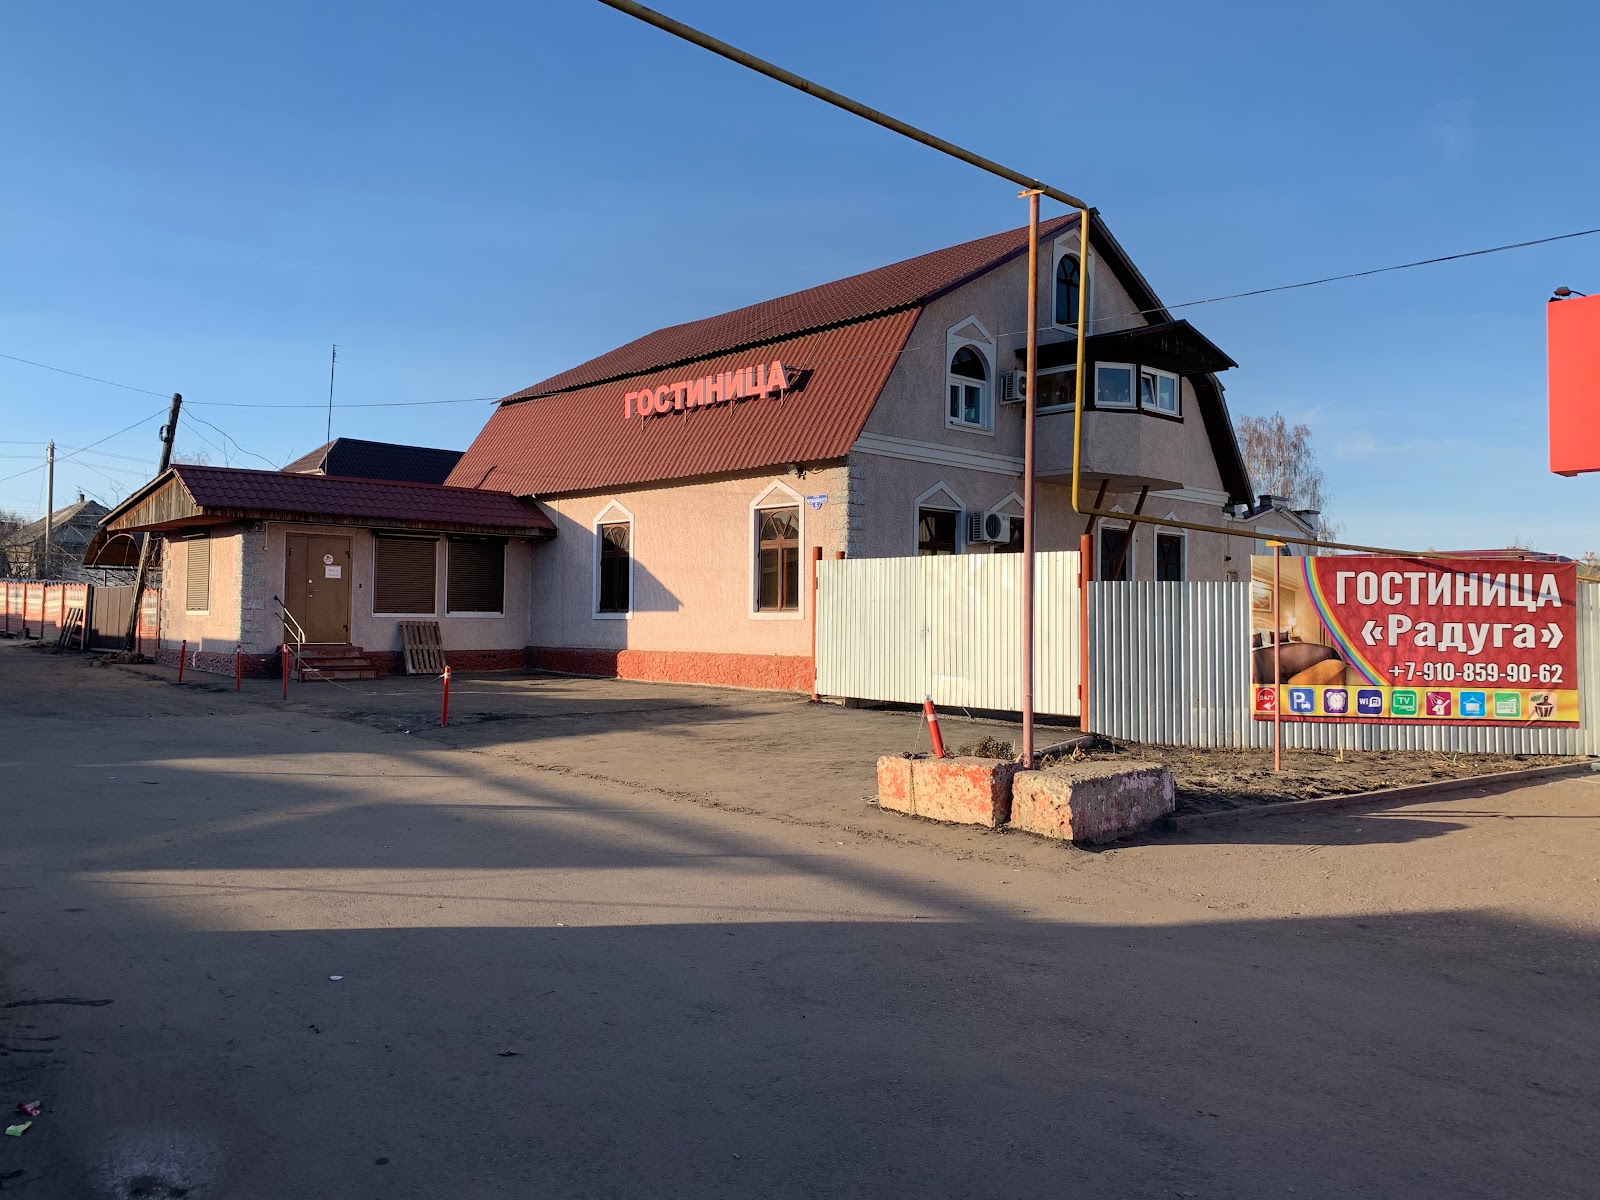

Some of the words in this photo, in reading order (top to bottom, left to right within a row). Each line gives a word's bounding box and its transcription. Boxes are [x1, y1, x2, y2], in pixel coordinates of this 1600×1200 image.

[624, 360, 788, 419] ГОСТИНИЦА
[1336, 571, 1562, 612] ГОСТИНИЦА
[1360, 613, 1564, 655] «Радуга»
[1388, 661, 1563, 683] +7-910-859-90-62
